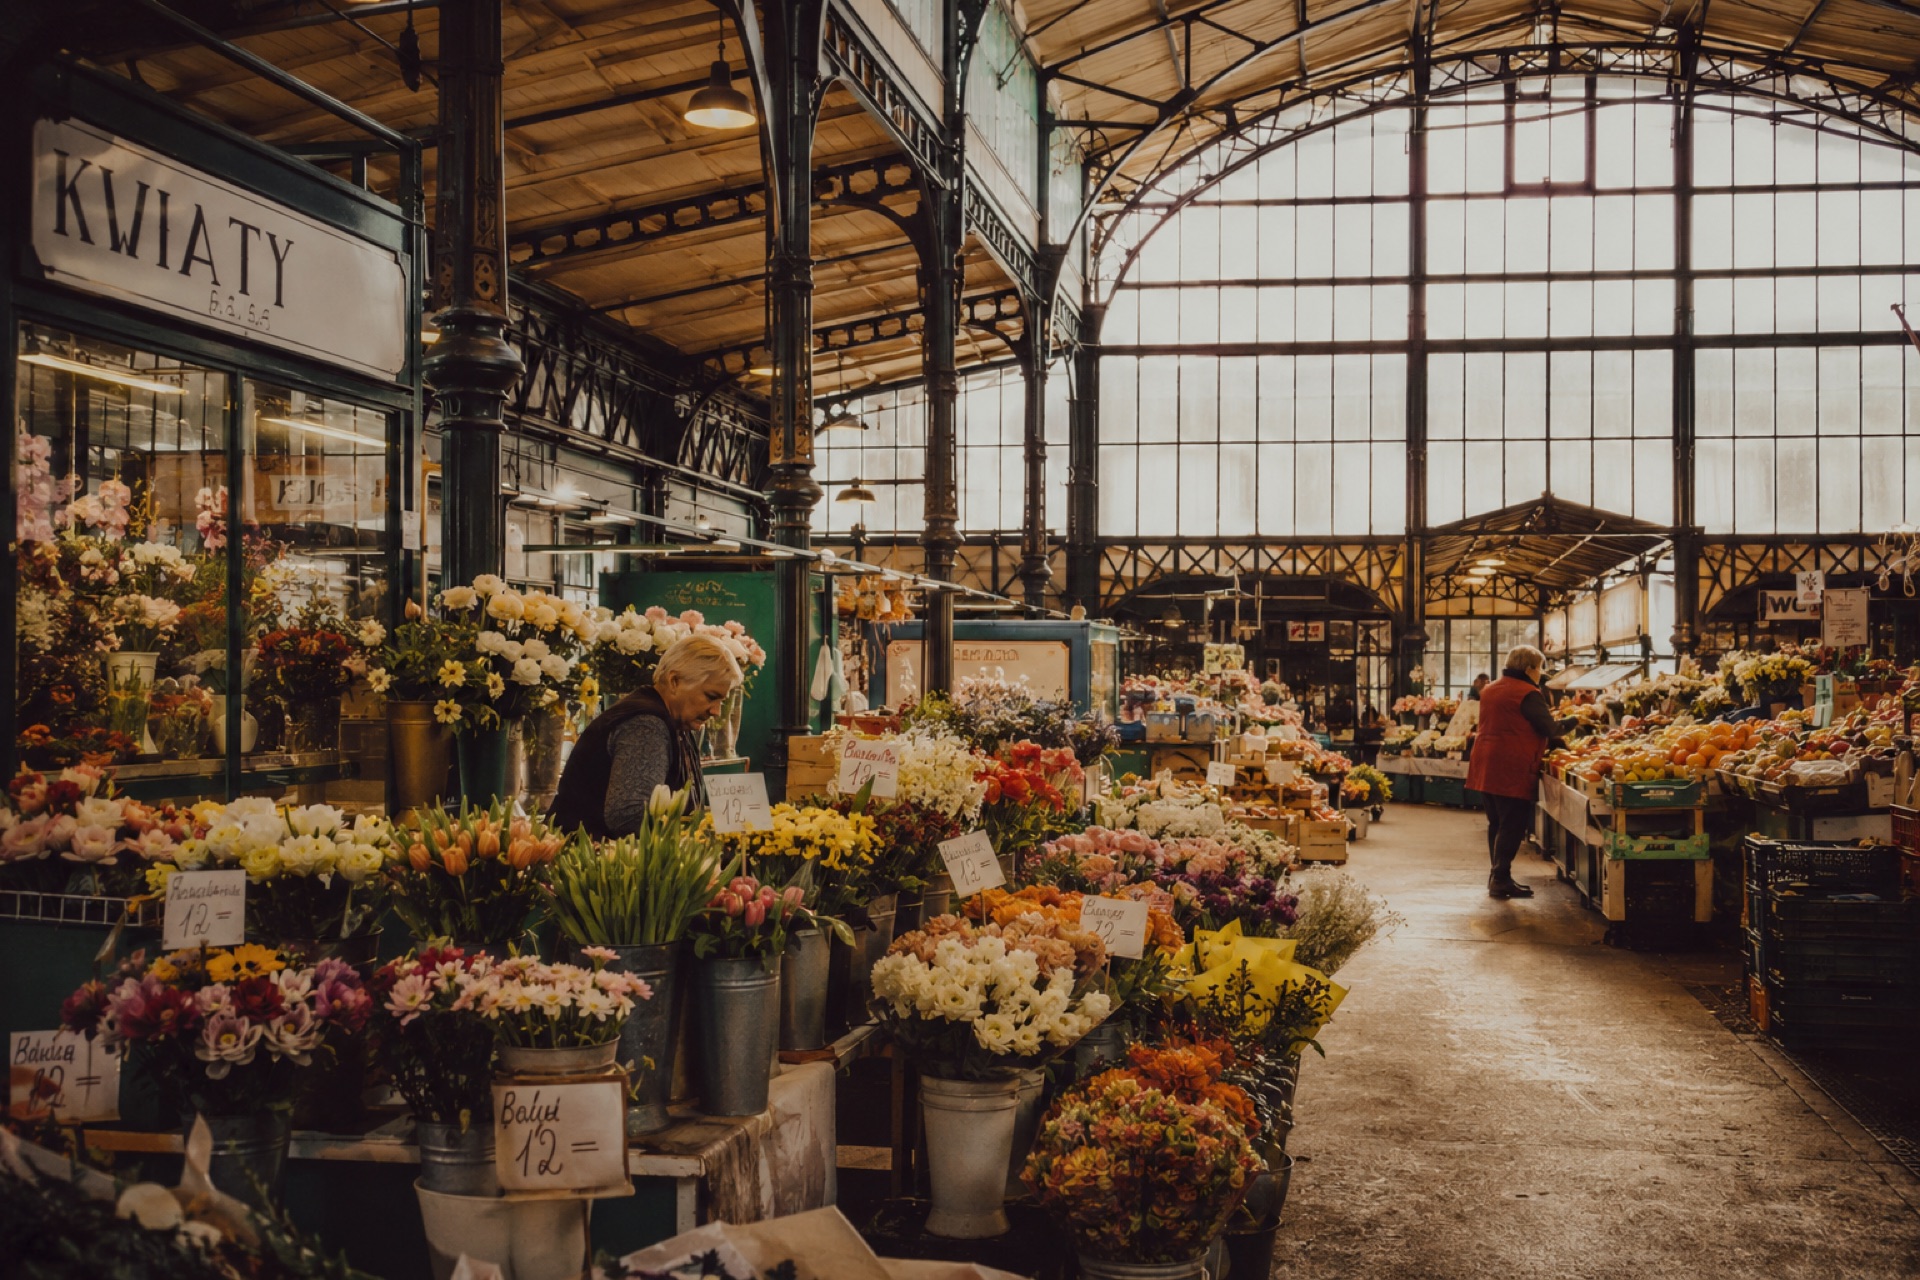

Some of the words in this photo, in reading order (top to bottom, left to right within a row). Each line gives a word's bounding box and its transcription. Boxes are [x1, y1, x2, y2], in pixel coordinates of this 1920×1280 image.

[53, 148, 295, 309] KWIATY
[178, 903, 211, 938] 12
[515, 1128, 563, 1177] 12
